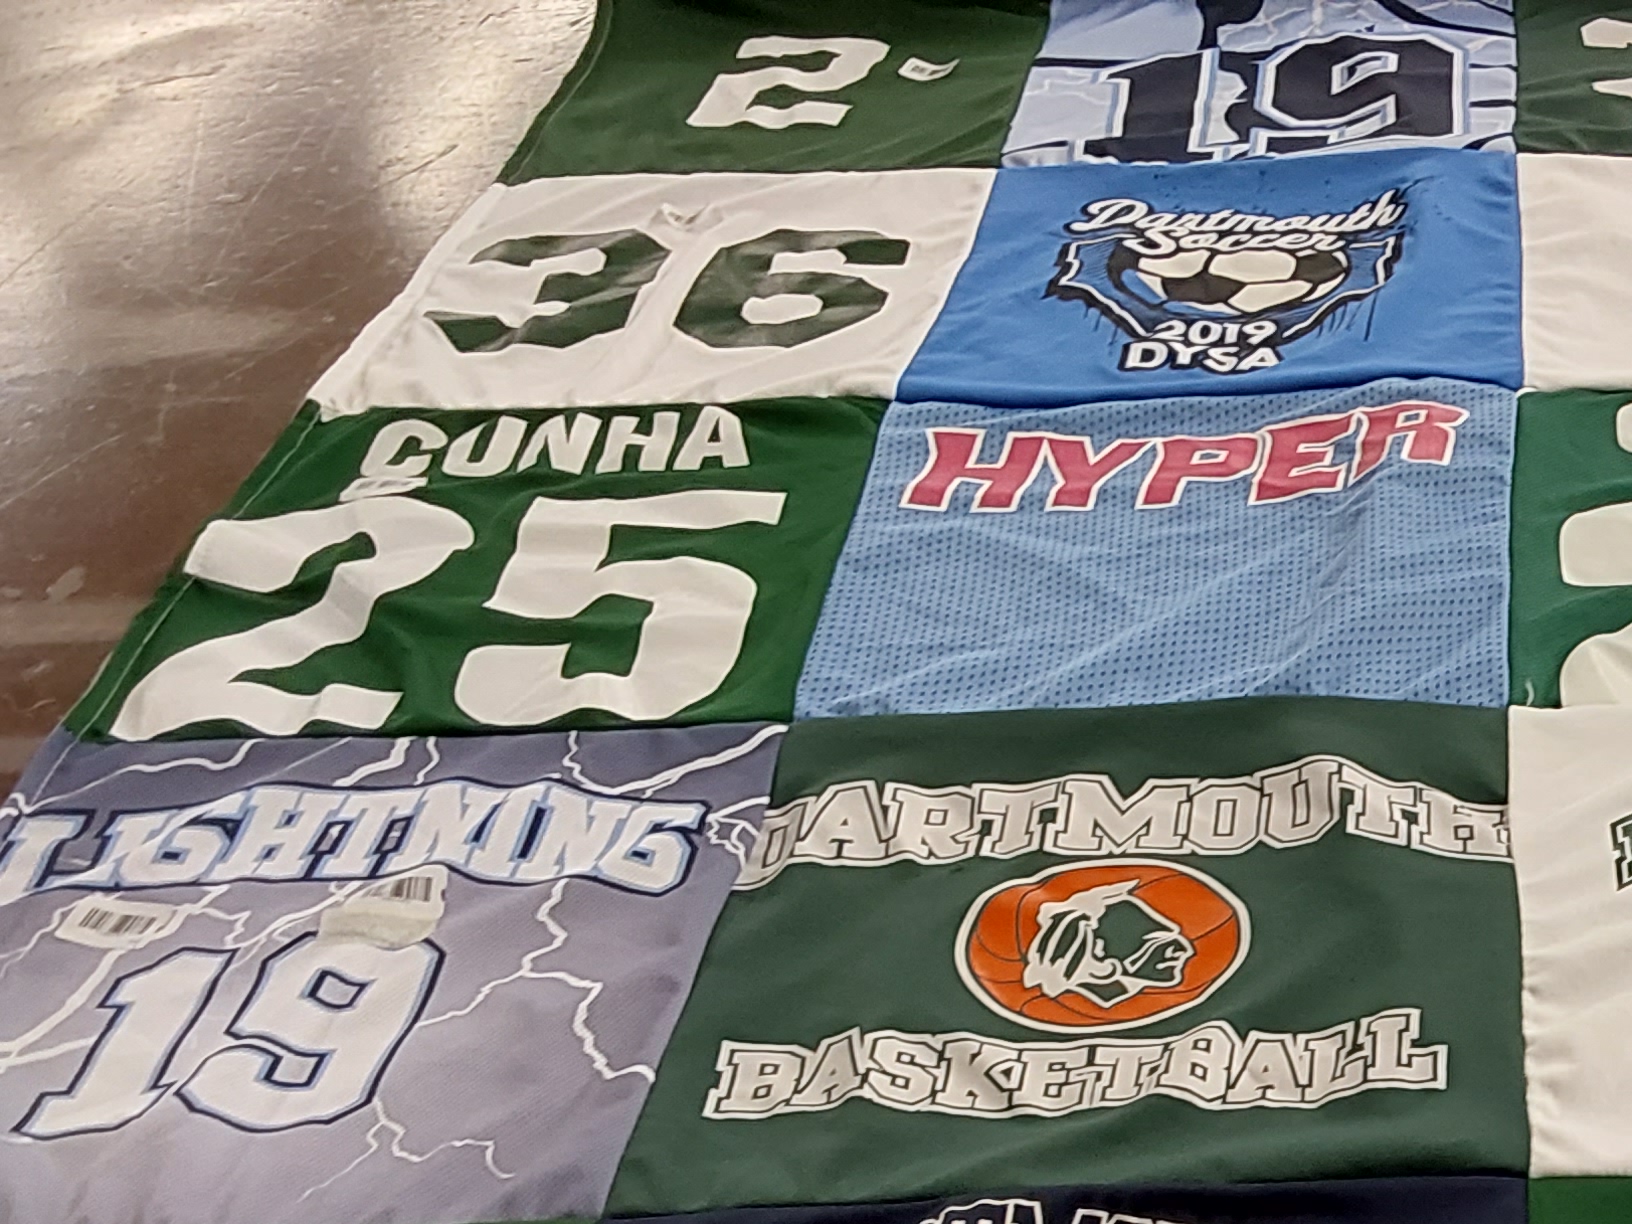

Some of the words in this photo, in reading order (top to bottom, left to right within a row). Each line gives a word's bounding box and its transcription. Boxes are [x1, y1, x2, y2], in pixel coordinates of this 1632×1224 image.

[685, 34, 892, 130] 2
[1070, 33, 1474, 165] 19
[1064, 187, 1407, 234] Dartmouth
[1120, 226, 1347, 256] Soccer
[424, 227, 911, 354] 36
[1151, 318, 1279, 345] 2019
[1122, 342, 1282, 373] DYSA
[343, 406, 752, 498] CUNHA
[900, 400, 1470, 512] HYPER
[109, 490, 788, 741] 25
[0, 778, 712, 904] LIGHTNING
[731, 755, 1516, 890] DARTMOUTH
[11, 930, 447, 1140] 19
[703, 1008, 1449, 1120] BASKETBALL
